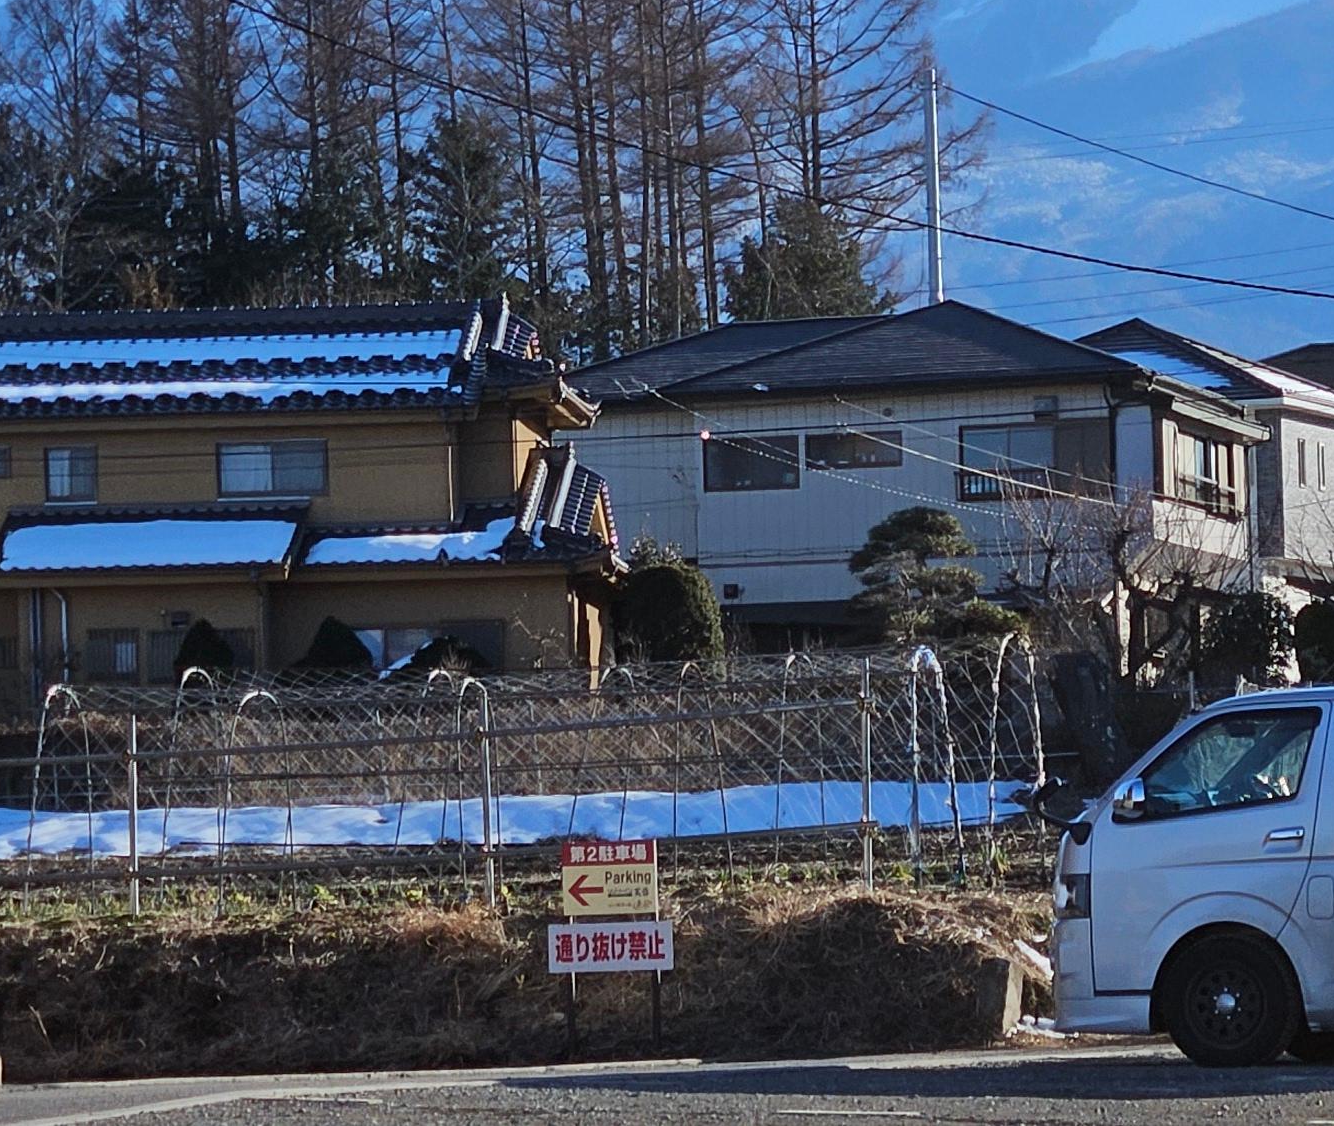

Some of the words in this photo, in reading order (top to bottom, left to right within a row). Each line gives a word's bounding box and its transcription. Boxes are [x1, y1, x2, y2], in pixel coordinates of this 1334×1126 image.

[570, 844, 647, 862] 第2駐車場
[605, 871, 652, 885] Parking
[555, 930, 665, 963] 通り抜け禁止
